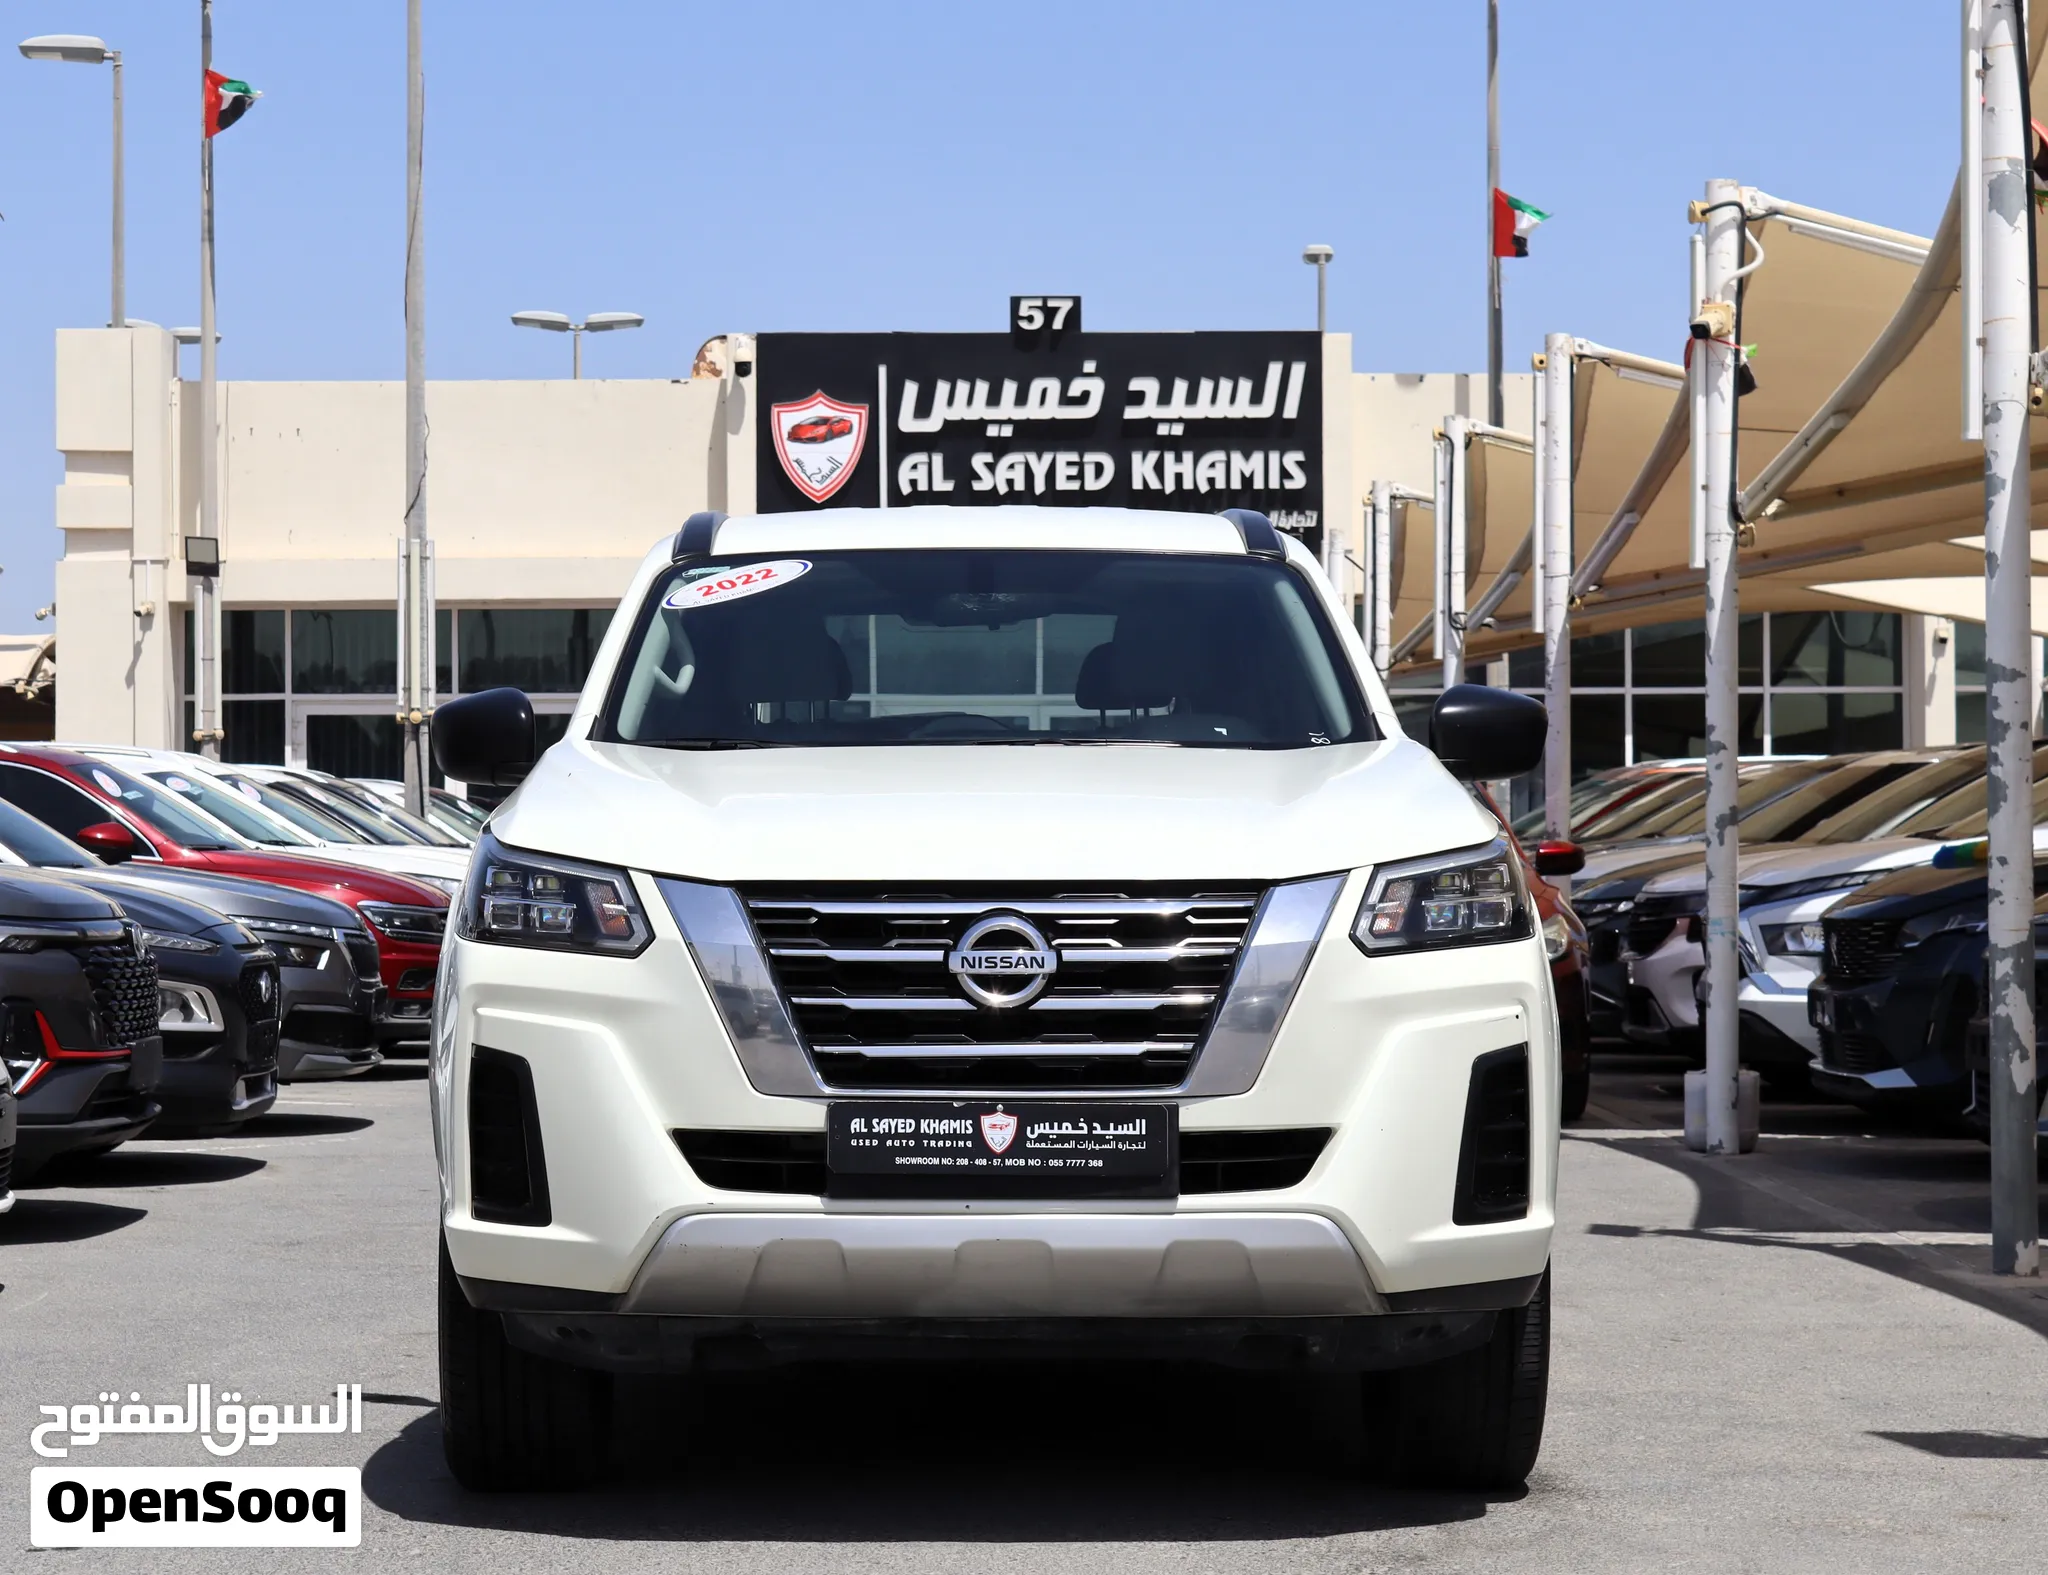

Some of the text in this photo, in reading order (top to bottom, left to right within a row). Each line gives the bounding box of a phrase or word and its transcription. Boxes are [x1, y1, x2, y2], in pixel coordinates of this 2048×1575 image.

[1017, 298, 1074, 330] 57
[898, 360, 1306, 437] السيد خميس
[899, 450, 1307, 496] AL SAYED KHAMIS
[696, 568, 779, 597] 2022
[961, 956, 1045, 968] NISSAN
[850, 1118, 973, 1135] AL SAYED KHAMIS
[1026, 1118, 1146, 1139] السيد خميس
[886, 1139, 915, 1147] AUTO
[923, 1140, 973, 1148] TRADING
[1026, 1140, 1146, 1151] لتجارة السيارات المستعملة
[895, 1157, 940, 1165] SHOWROOM
[974, 1158, 987, 1166] 408
[1005, 1158, 1026, 1166] MOB
[1048, 1159, 1065, 1167] 055
[1066, 1159, 1087, 1167] 7777
[1087, 1159, 1104, 1167] 368
